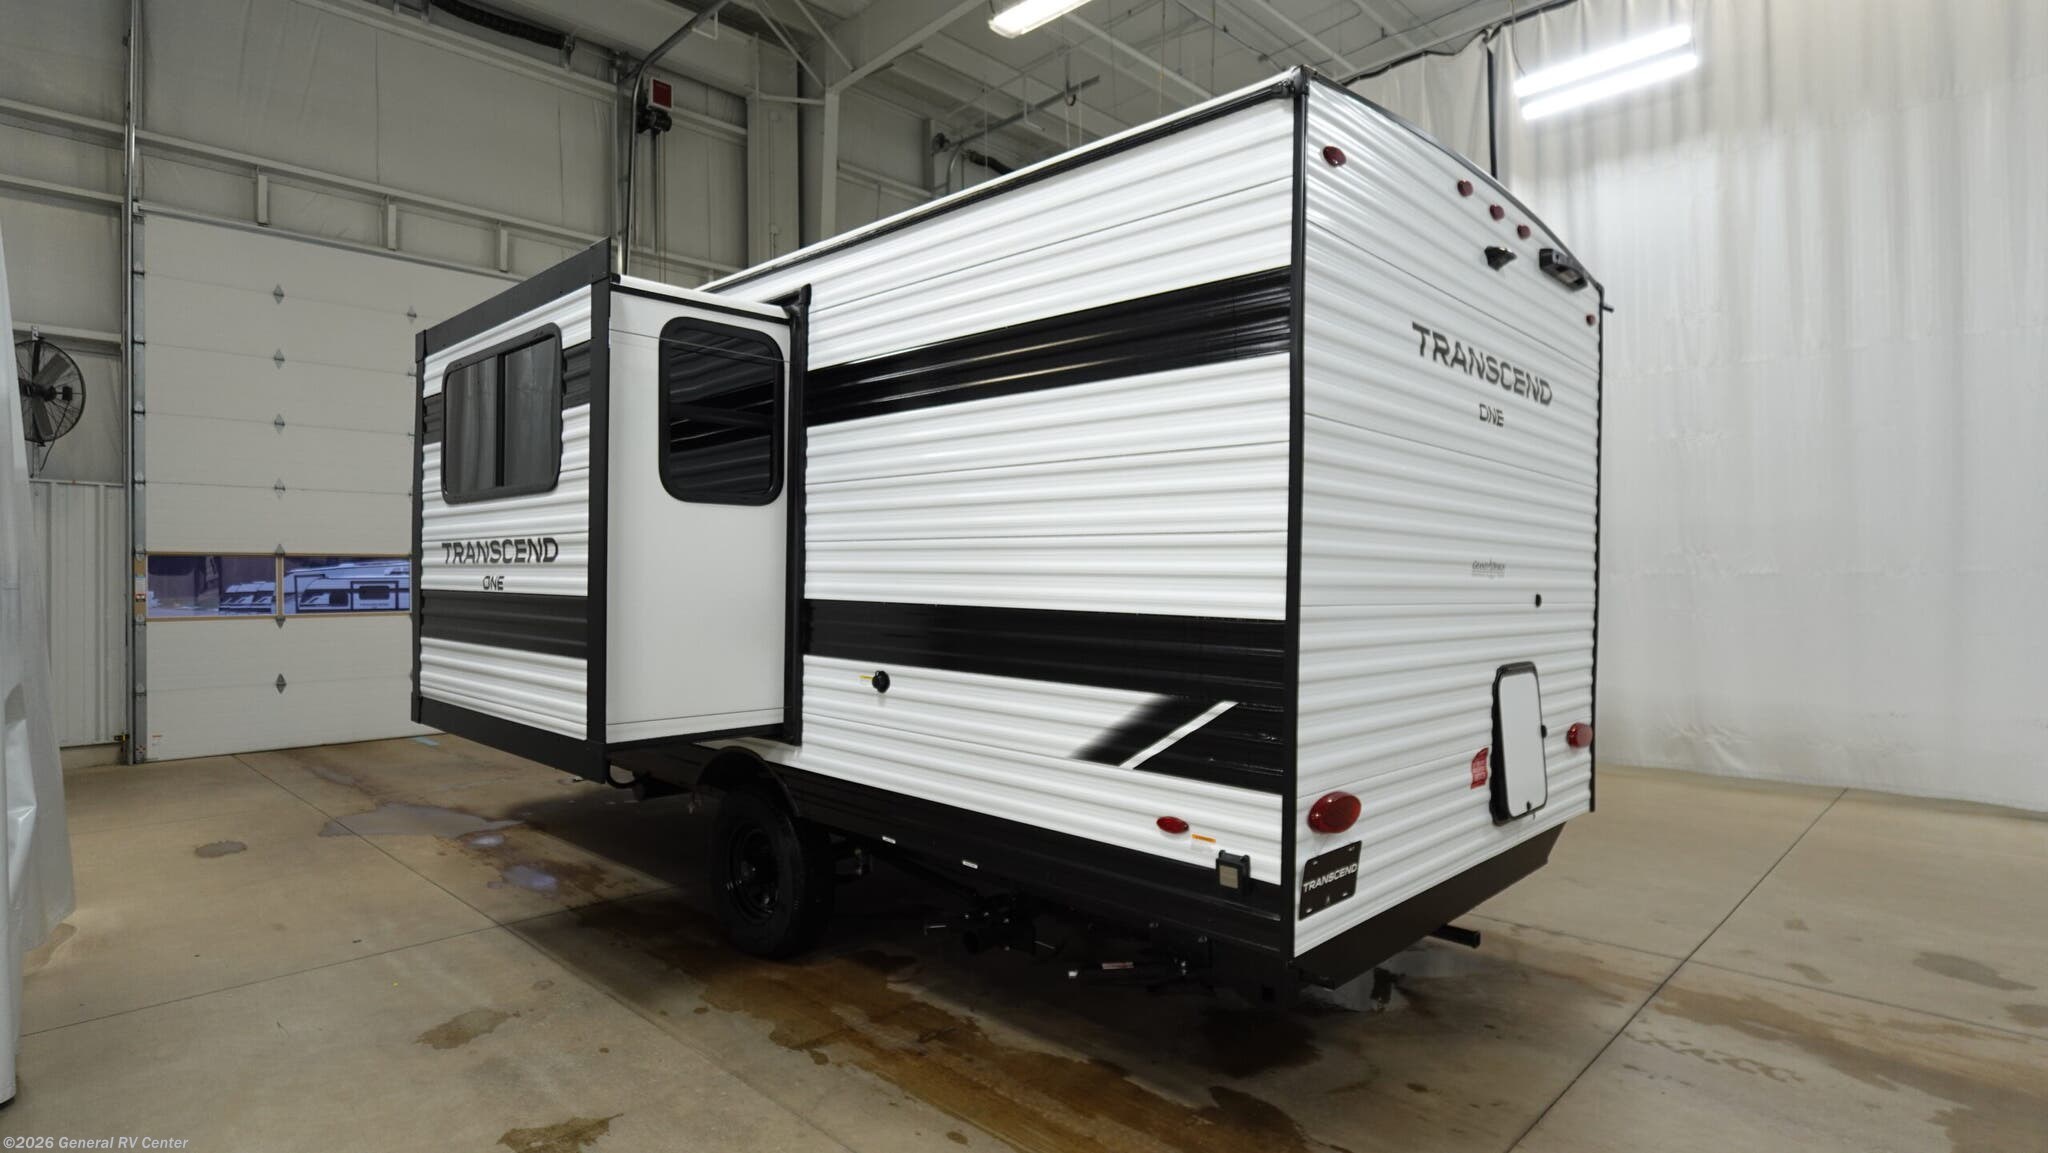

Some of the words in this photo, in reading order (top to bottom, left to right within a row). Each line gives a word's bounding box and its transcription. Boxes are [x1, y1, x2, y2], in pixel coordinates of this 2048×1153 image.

[1412, 321, 1553, 406] TRANSCEND
[1479, 403, 1504, 428] ONE
[441, 537, 559, 564] TRANSCEND
[482, 575, 505, 591] ONE
[1303, 863, 1358, 893] TRANSCEND
